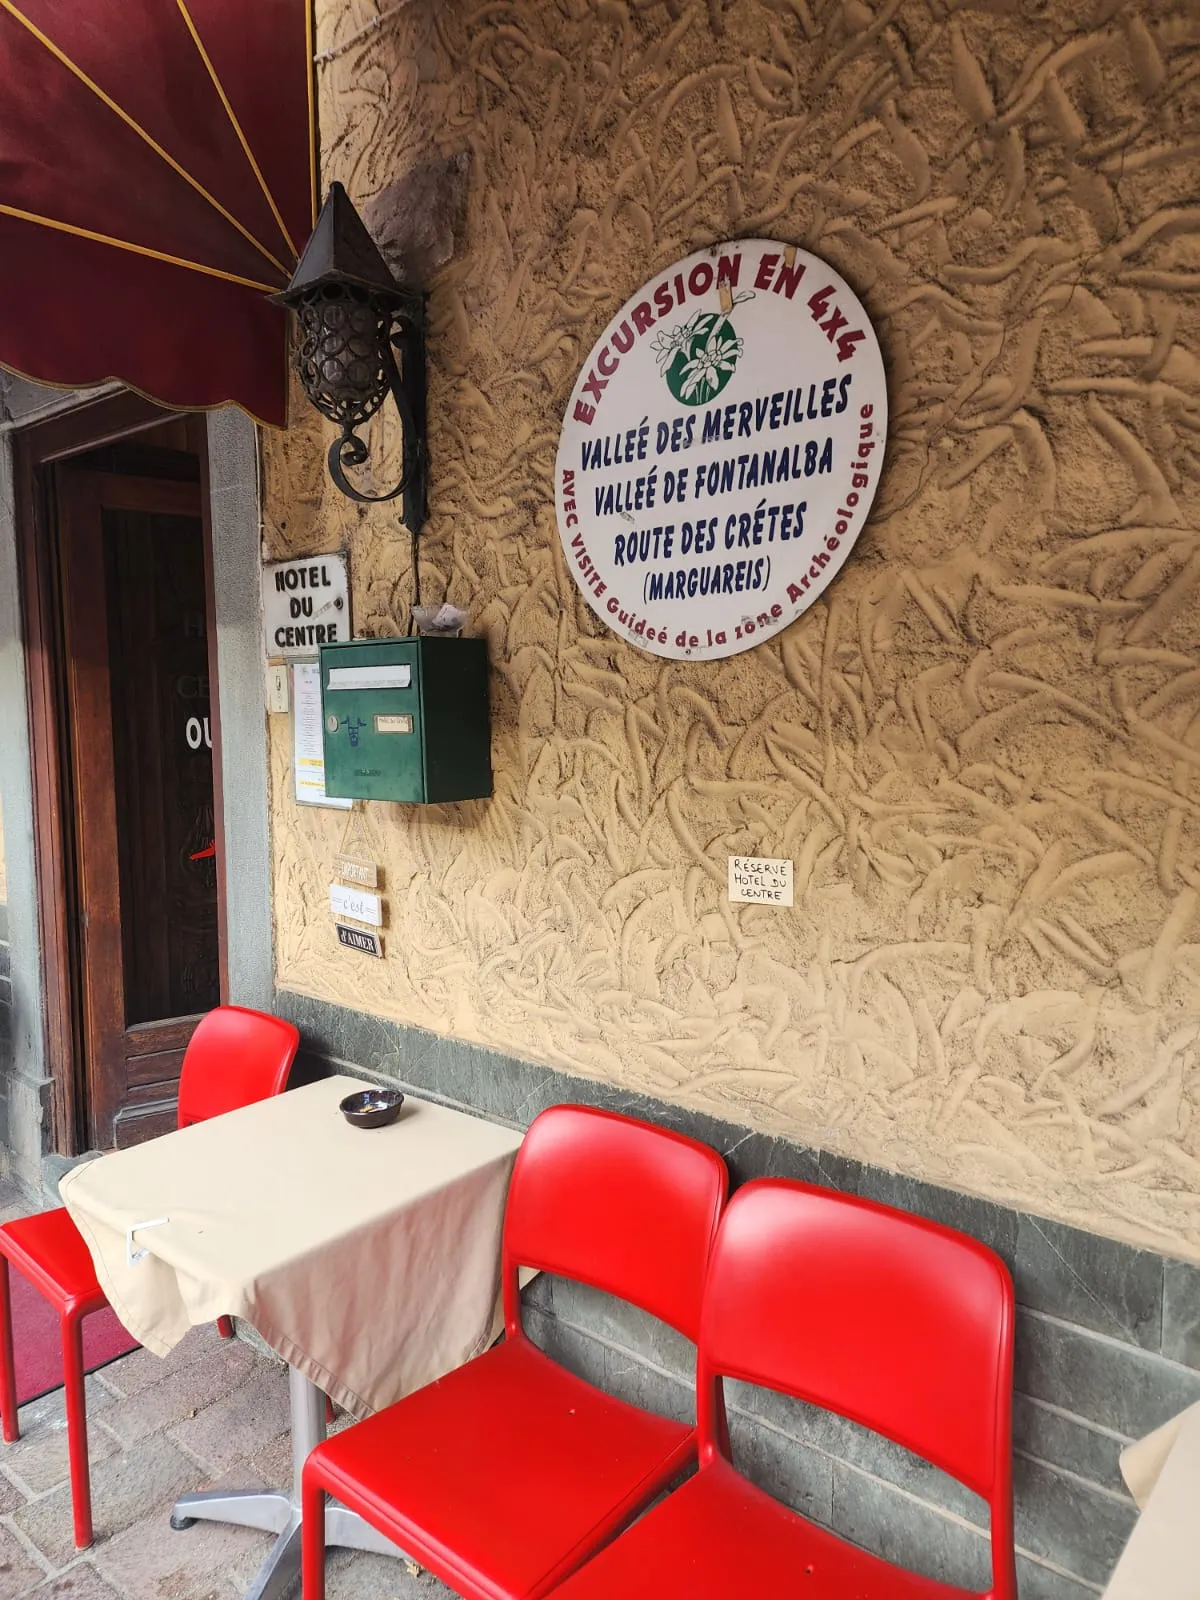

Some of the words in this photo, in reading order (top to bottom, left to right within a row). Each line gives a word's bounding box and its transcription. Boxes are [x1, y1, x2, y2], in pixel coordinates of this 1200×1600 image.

[573, 253, 742, 426] EXCURSION
[754, 254, 807, 299] EN
[582, 416, 650, 471] VALLEÉ
[656, 414, 696, 455] DES
[702, 374, 852, 444] MERVEILLES
[595, 465, 658, 516] VALLEÉ
[664, 468, 689, 504] DE
[694, 437, 833, 499] FONTANALBA
[562, 469, 579, 528] AVEC
[571, 533, 608, 598] VISITE
[606, 597, 668, 644] Guideé
[675, 631, 699, 648] de
[706, 630, 727, 647] la
[735, 603, 783, 640] zone
[786, 403, 875, 604] Archéologique
[614, 525, 675, 567] ROUTE
[682, 517, 718, 554] DES
[724, 498, 807, 548] CRÉTES
[275, 565, 331, 592] HOTEL
[643, 555, 771, 605] (MARGUAREIS)
[290, 596, 313, 619] DU
[274, 623, 338, 648] CENTRE
[734, 858, 787, 876] RÉSERVÉ
[734, 873, 766, 887] HOTEL
[770, 879, 787, 888] DU
[741, 888, 782, 900] CENTRE
